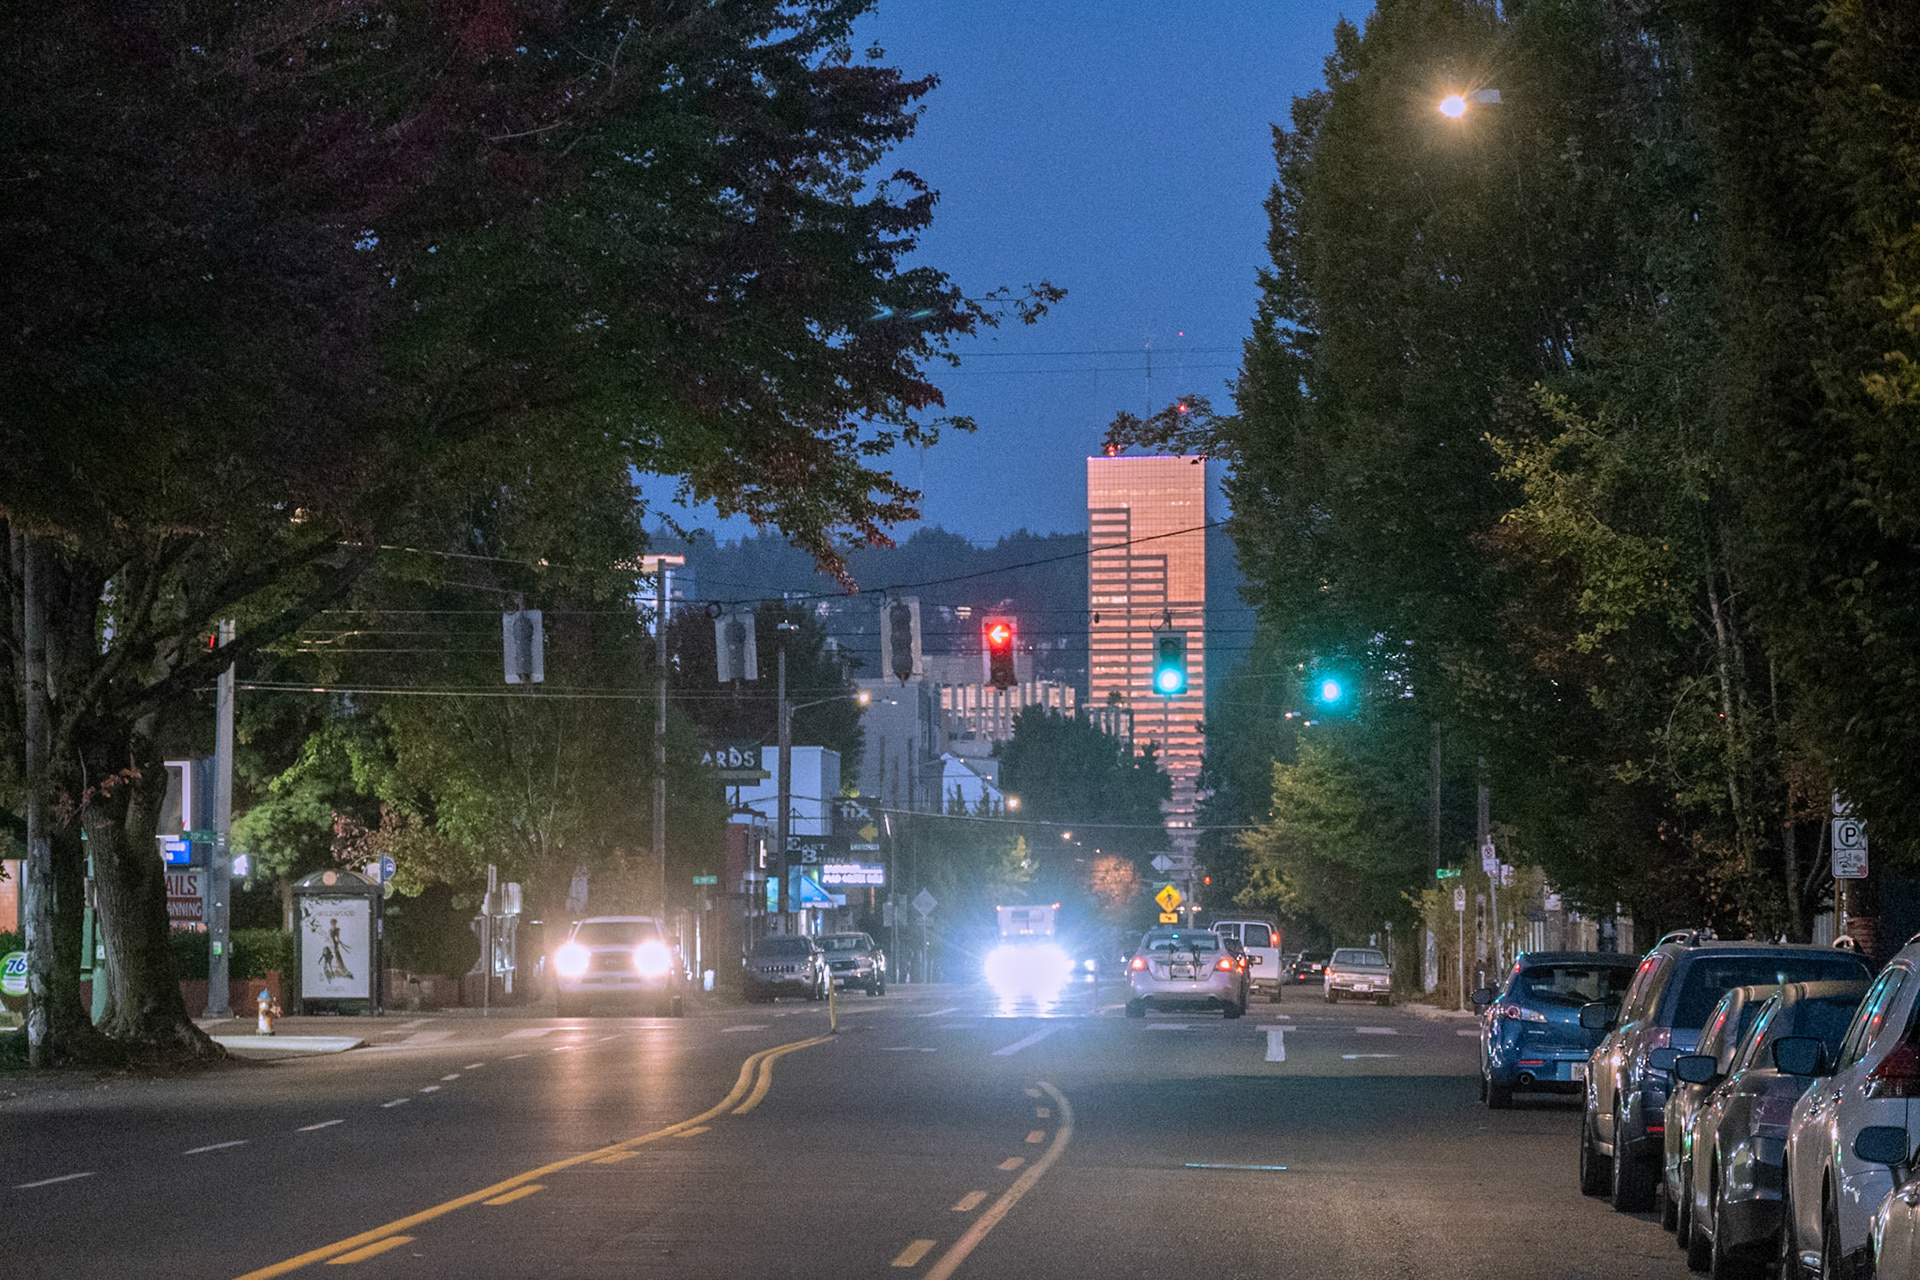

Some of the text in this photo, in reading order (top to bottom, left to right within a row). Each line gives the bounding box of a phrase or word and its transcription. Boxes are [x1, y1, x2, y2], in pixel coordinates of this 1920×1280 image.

[701, 748, 755, 767] ARDS
[1845, 827, 1856, 842] P
[8, 958, 26, 972] 76
